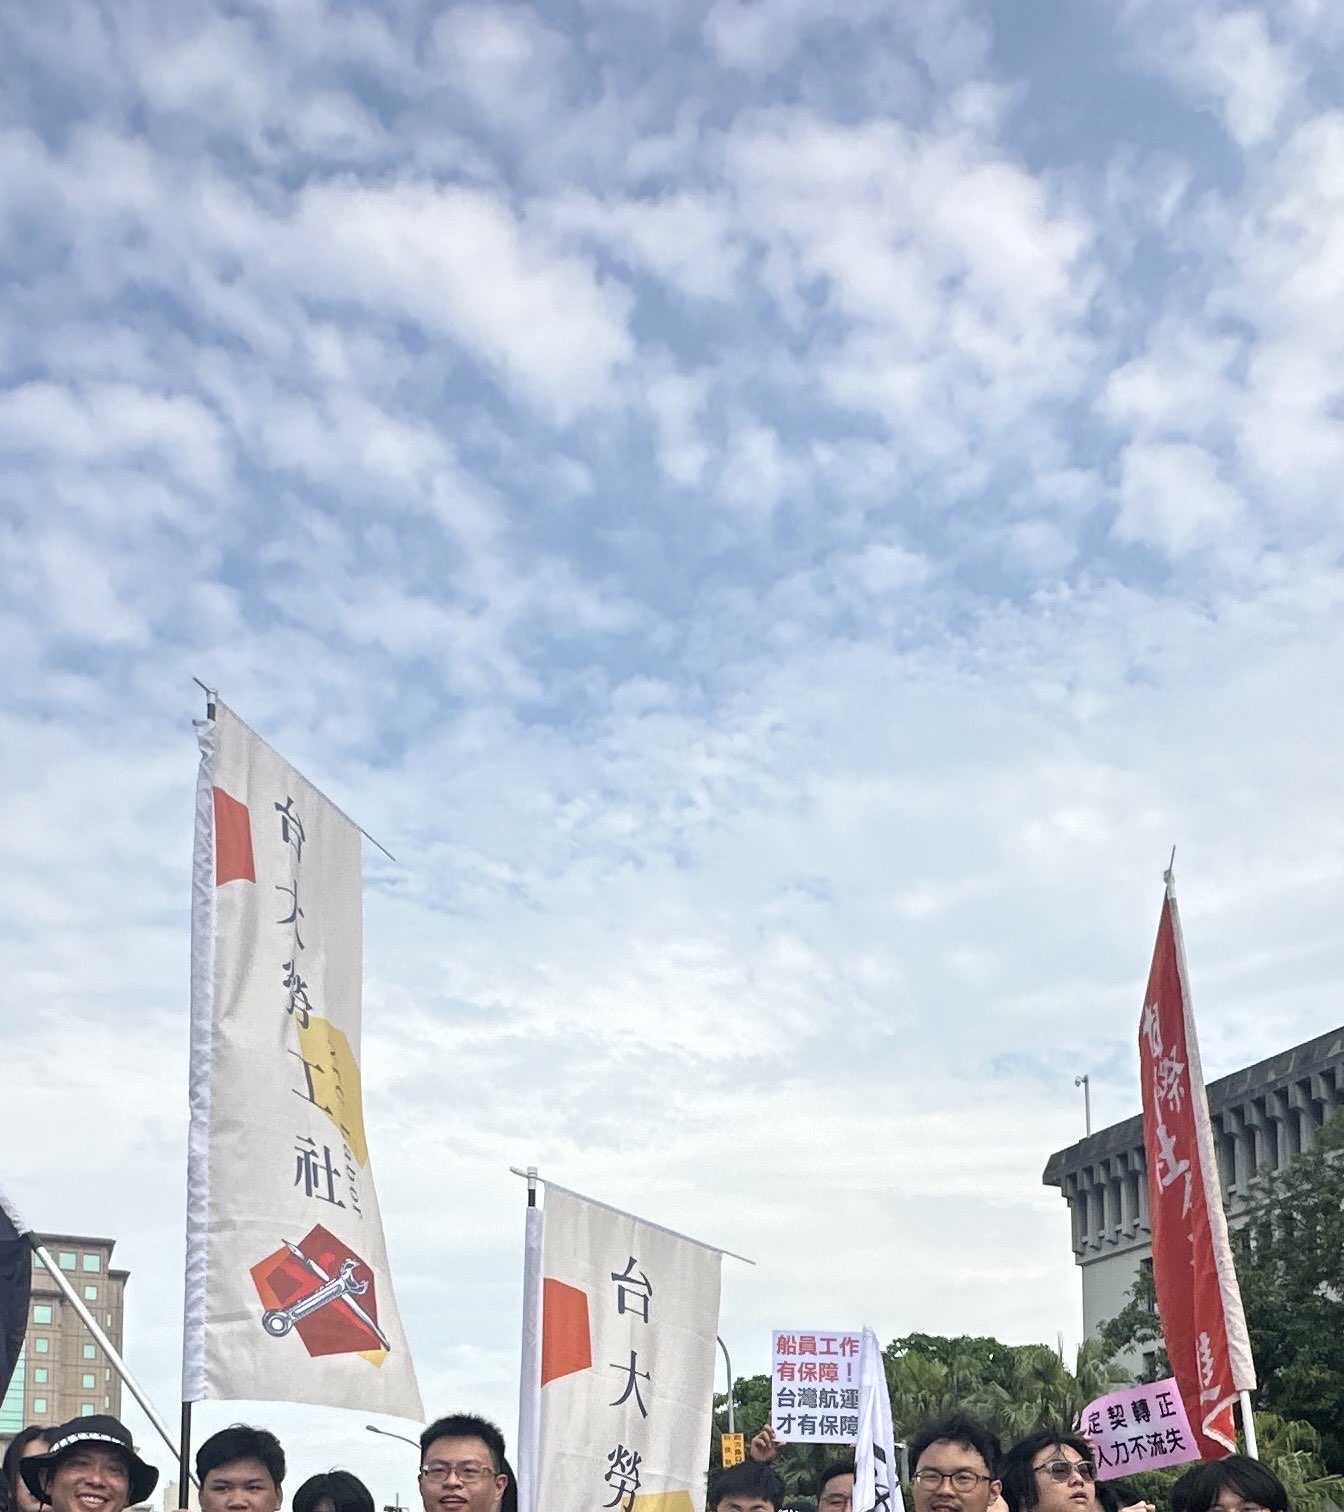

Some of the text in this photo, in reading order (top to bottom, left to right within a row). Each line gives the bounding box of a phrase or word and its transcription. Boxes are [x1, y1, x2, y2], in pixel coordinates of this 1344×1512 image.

[776, 1335, 859, 1357] 船員工作
[777, 1361, 852, 1383] 有保障！
[777, 1387, 859, 1409] 台灣航運
[776, 1413, 858, 1436] 才有保障
[1097, 1428, 1186, 1469] 人力不流失
